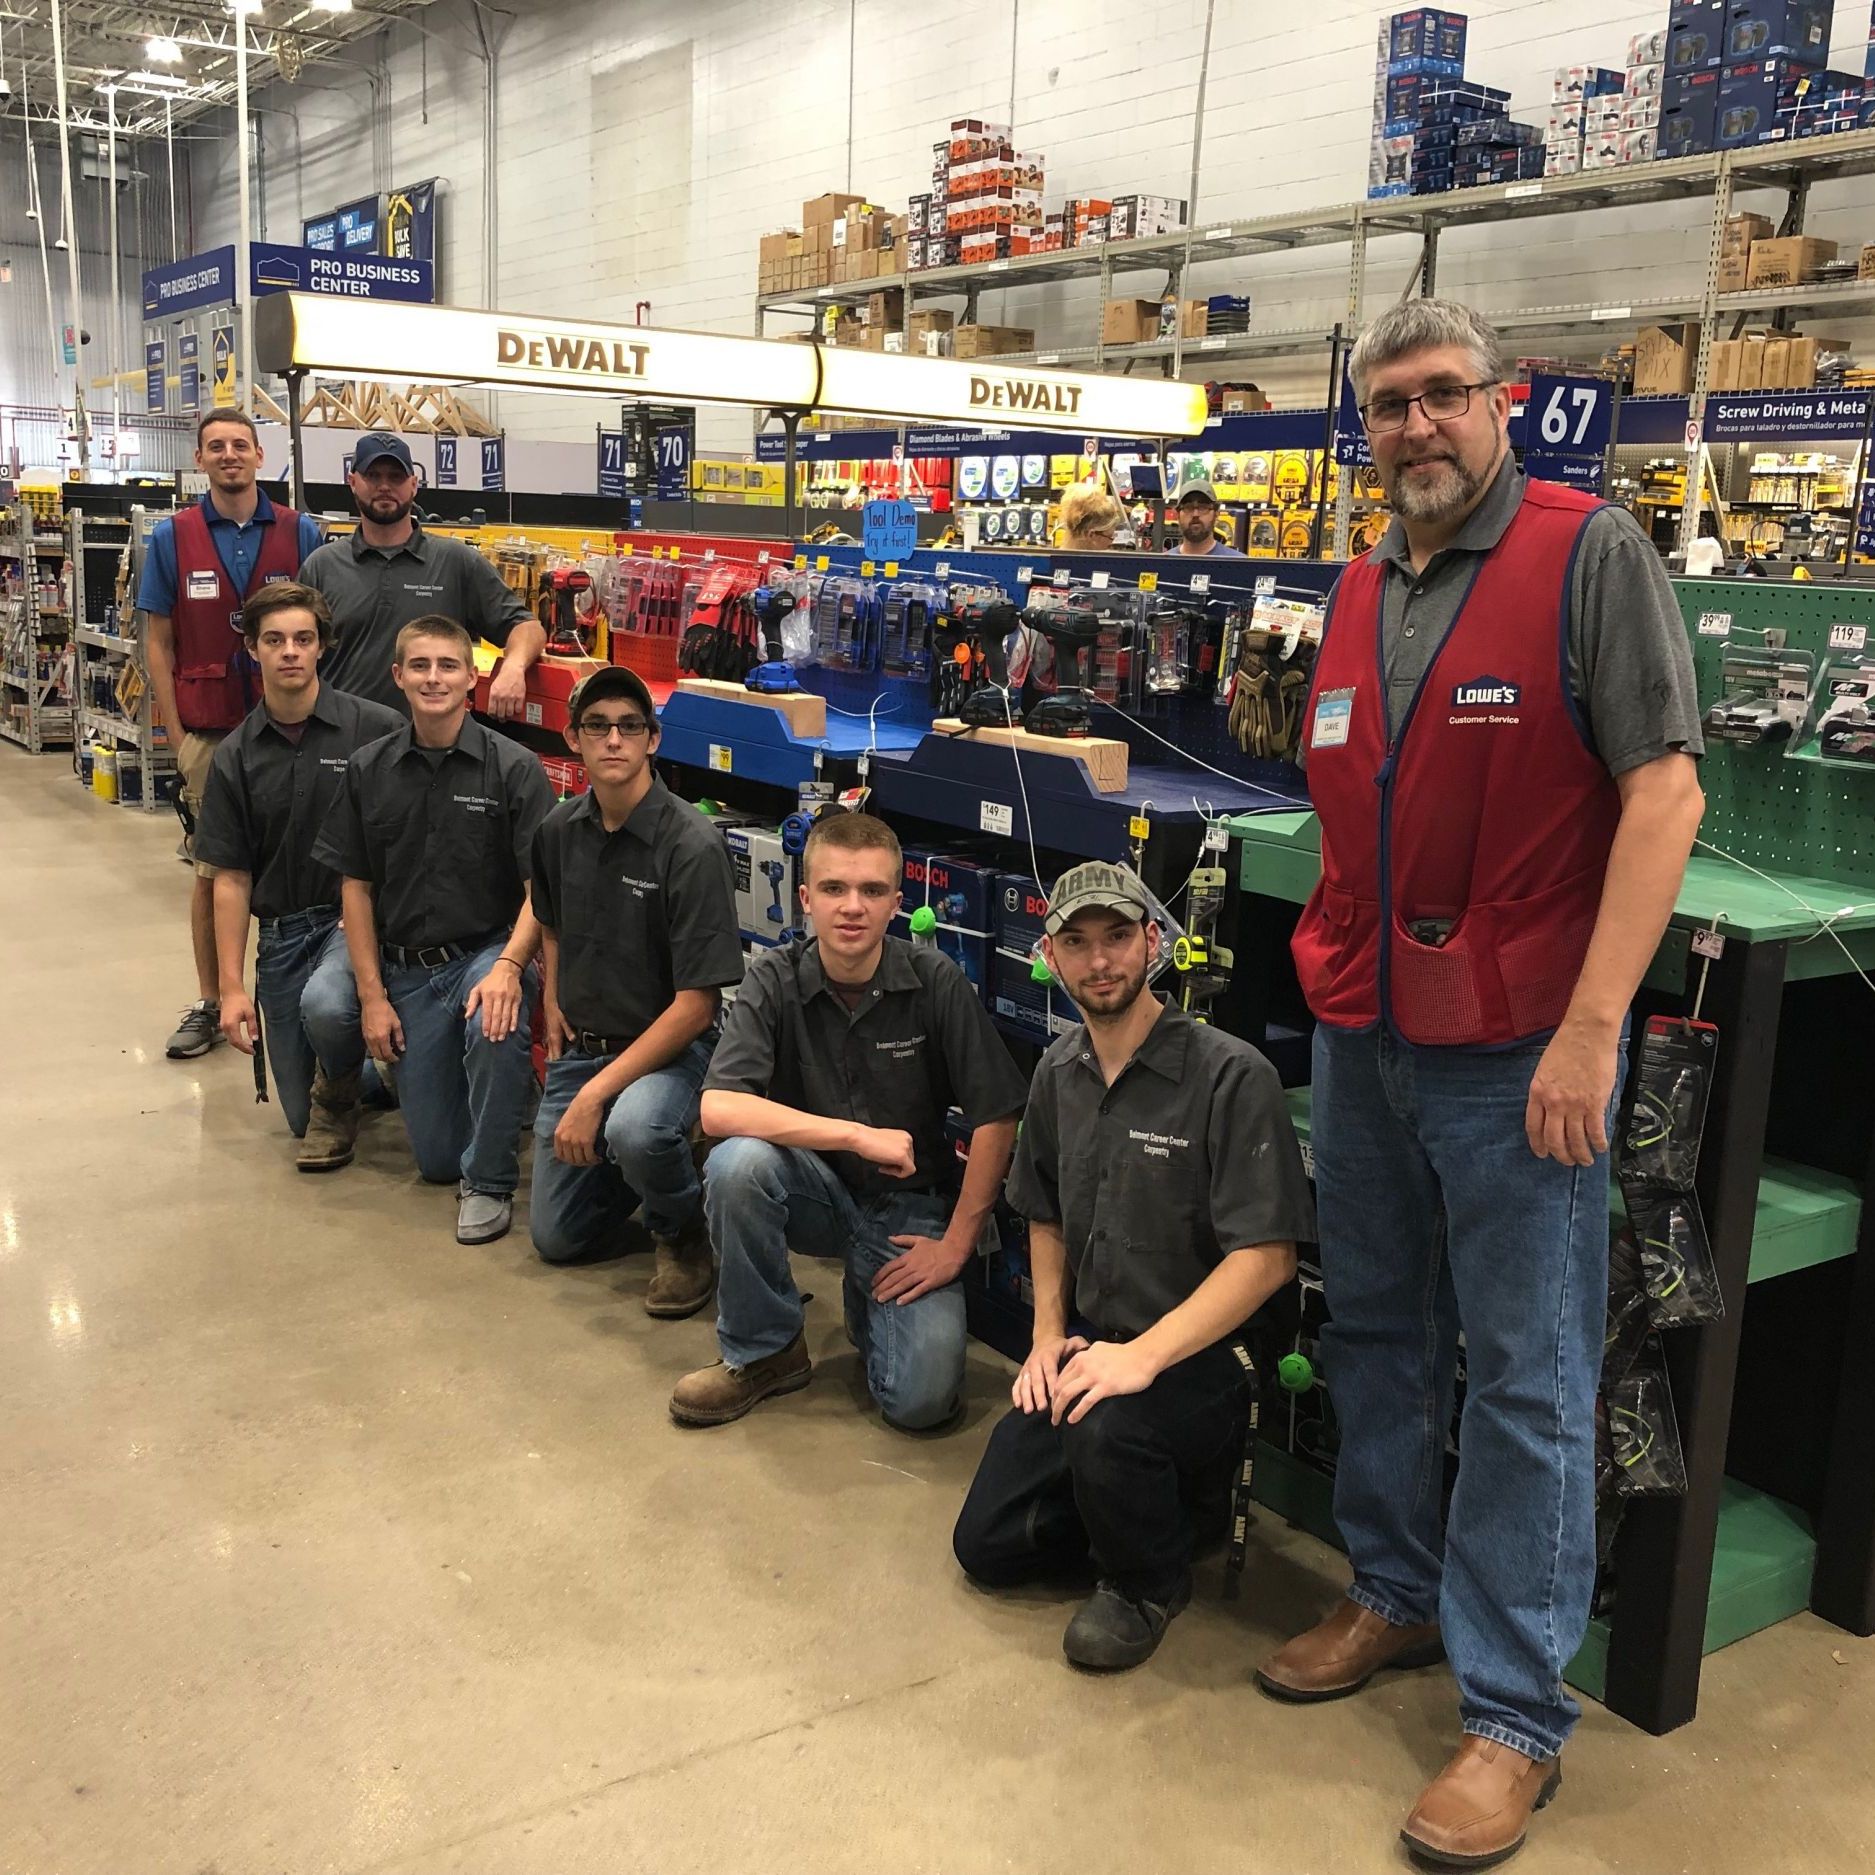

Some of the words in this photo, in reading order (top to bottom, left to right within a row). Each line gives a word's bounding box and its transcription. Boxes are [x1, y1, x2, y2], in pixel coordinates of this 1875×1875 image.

[160, 282, 172, 299] PRO
[172, 273, 197, 297] BUSINESS
[198, 267, 220, 288] CENTER
[310, 259, 342, 276] PRO
[346, 263, 421, 284] BUSINESS
[310, 276, 370, 296] CENTER
[497, 331, 651, 377] DEWALT
[969, 377, 1083, 414] DEWALT
[1541, 385, 1598, 446] 67
[1717, 405, 1759, 419] Screw
[1762, 403, 1813, 419] Driving
[1816, 401, 1826, 416] &
[1830, 401, 1866, 415] Meta
[909, 434, 934, 443] Diamond
[935, 434, 955, 443] Blades
[961, 433, 987, 442] Abrasive
[1715, 424, 1739, 432] Brocas
[1739, 424, 1755, 432] para
[1787, 422, 1836, 430] destornillador
[1837, 421, 1855, 430] para
[605, 439, 621, 468] 71
[662, 435, 683, 467] 70
[760, 440, 774, 449] Power
[774, 440, 784, 448] Tool
[440, 444, 453, 469] 72
[485, 444, 498, 470] 71
[1356, 453, 1373, 463] Pow
[1563, 465, 1588, 475] Sanders
[866, 504, 887, 527] Tool
[892, 504, 916, 526] Demo
[866, 531, 879, 555] Try
[882, 532, 888, 547] it
[1456, 686, 1515, 705] LOWE'S
[1325, 722, 1340, 731] DAVE
[1448, 716, 1487, 725] Customer
[1488, 714, 1520, 724] Service
[728, 837, 748, 850] KOBALT
[906, 860, 949, 888] BOSCH
[1055, 866, 1125, 905] ARMY
[1150, 1132, 1169, 1144] Career
[1169, 1136, 1190, 1147] Center
